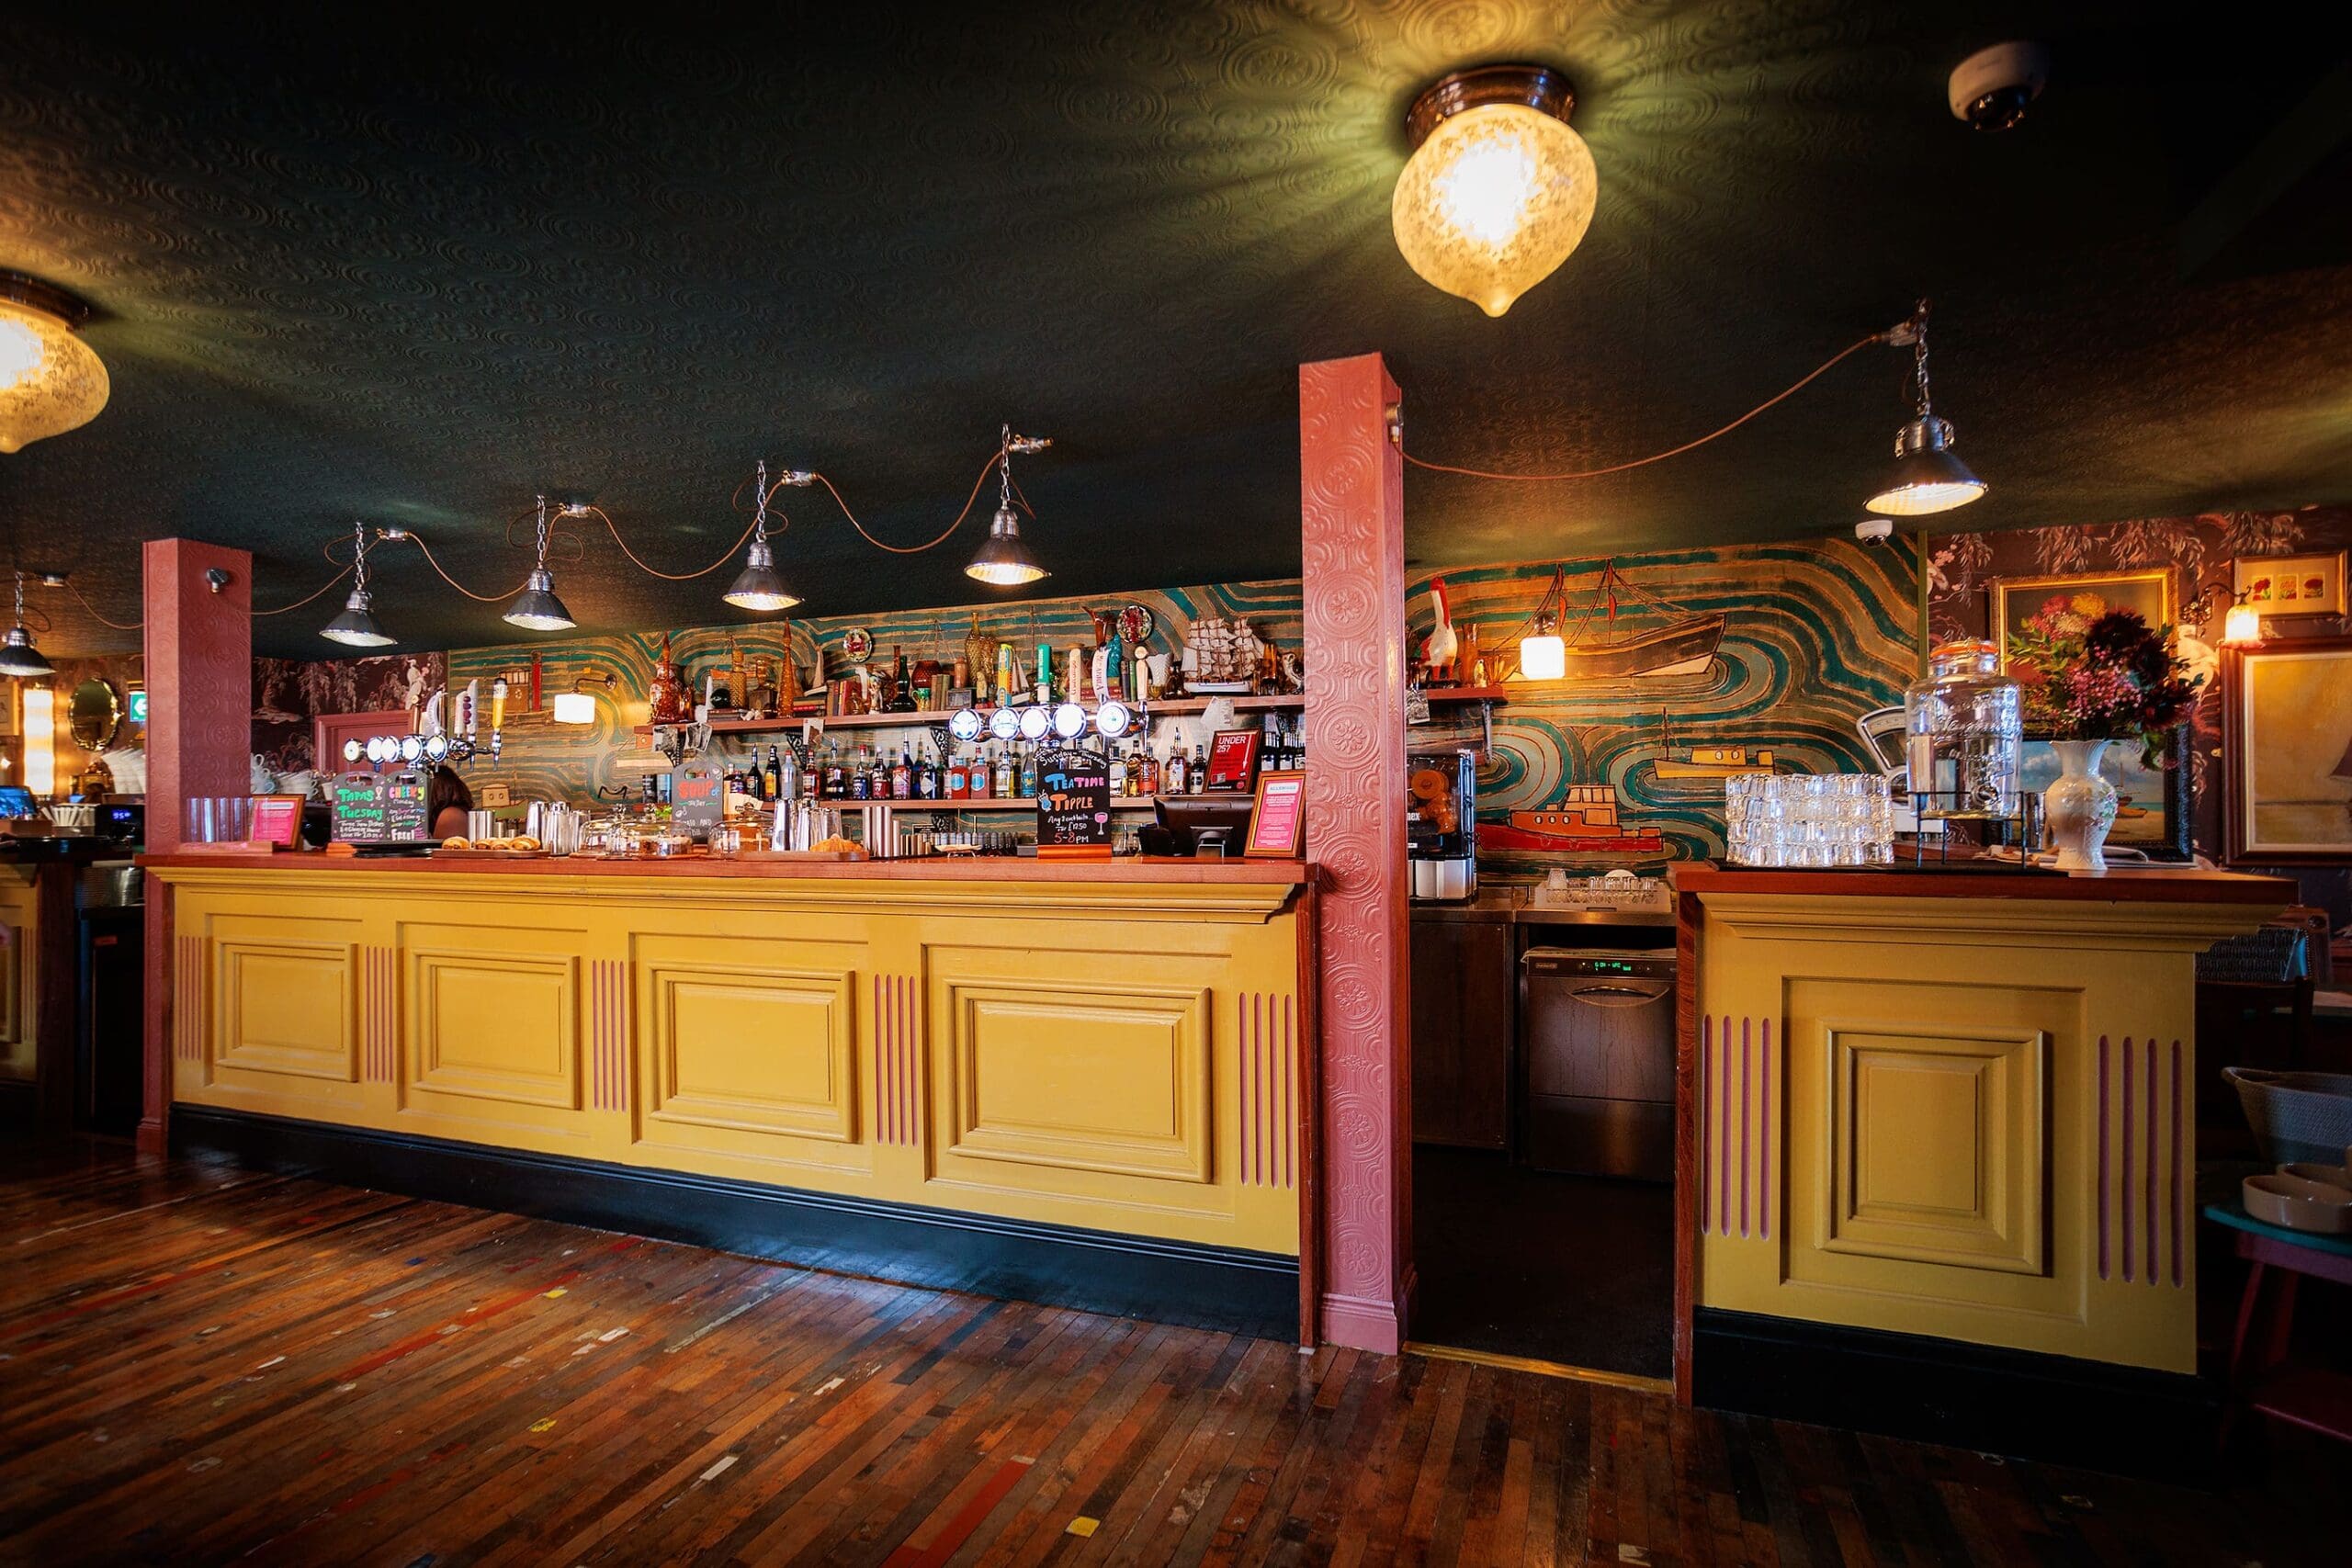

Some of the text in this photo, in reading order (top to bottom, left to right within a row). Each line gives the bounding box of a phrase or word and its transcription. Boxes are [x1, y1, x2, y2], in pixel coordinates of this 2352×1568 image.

[1218, 736, 1246, 744] UNDER
[1216, 744, 1230, 753] 25?
[678, 780, 714, 799] SOUP
